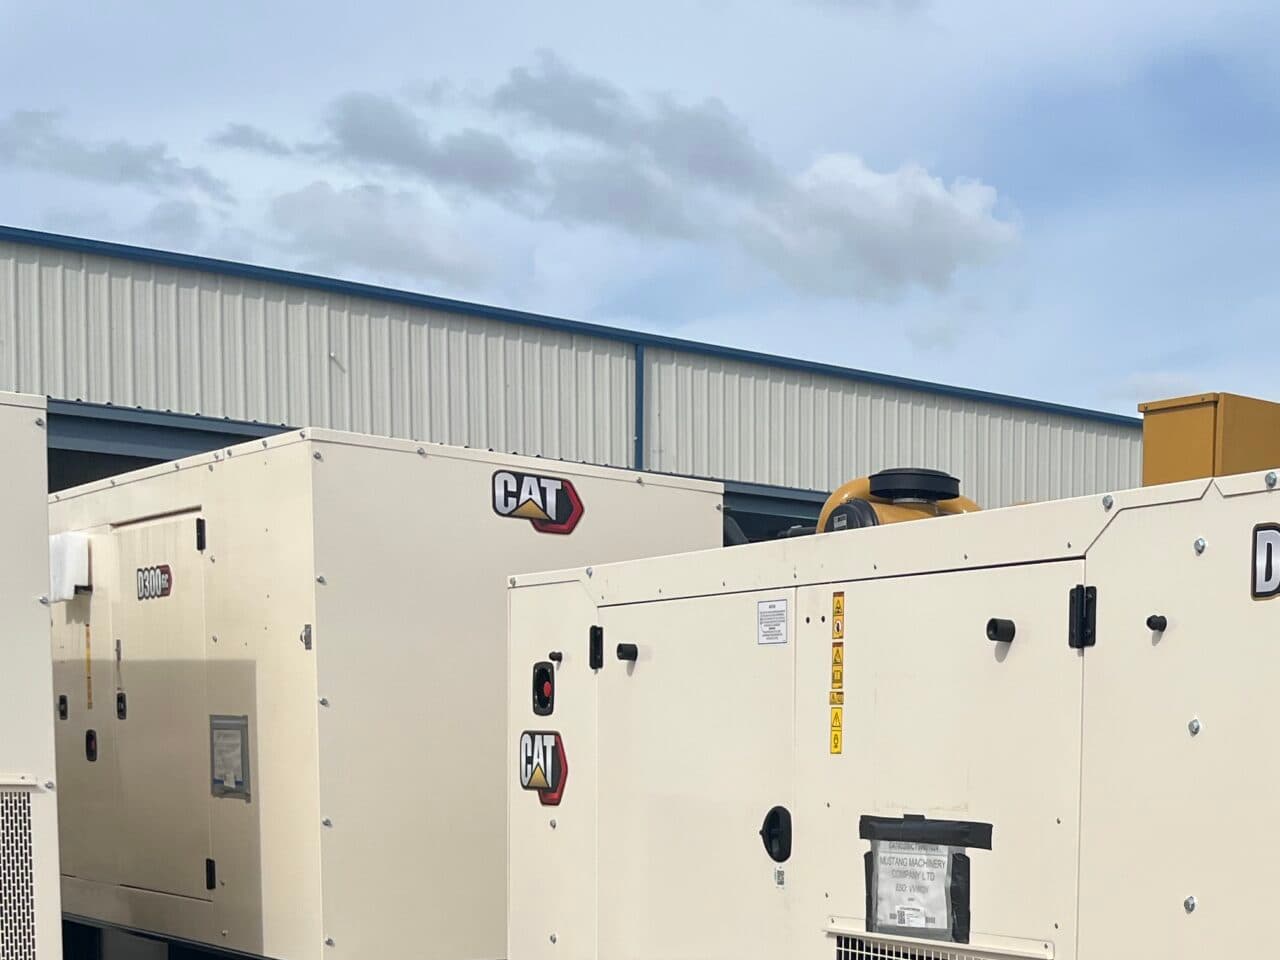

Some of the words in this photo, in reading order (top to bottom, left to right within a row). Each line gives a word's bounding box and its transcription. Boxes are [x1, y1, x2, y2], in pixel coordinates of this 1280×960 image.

[495, 472, 561, 520] CAT
[137, 568, 161, 598] D300
[521, 733, 555, 788] CAT
[880, 856, 908, 867] MUSTANG
[909, 857, 946, 869] MACHINERY
